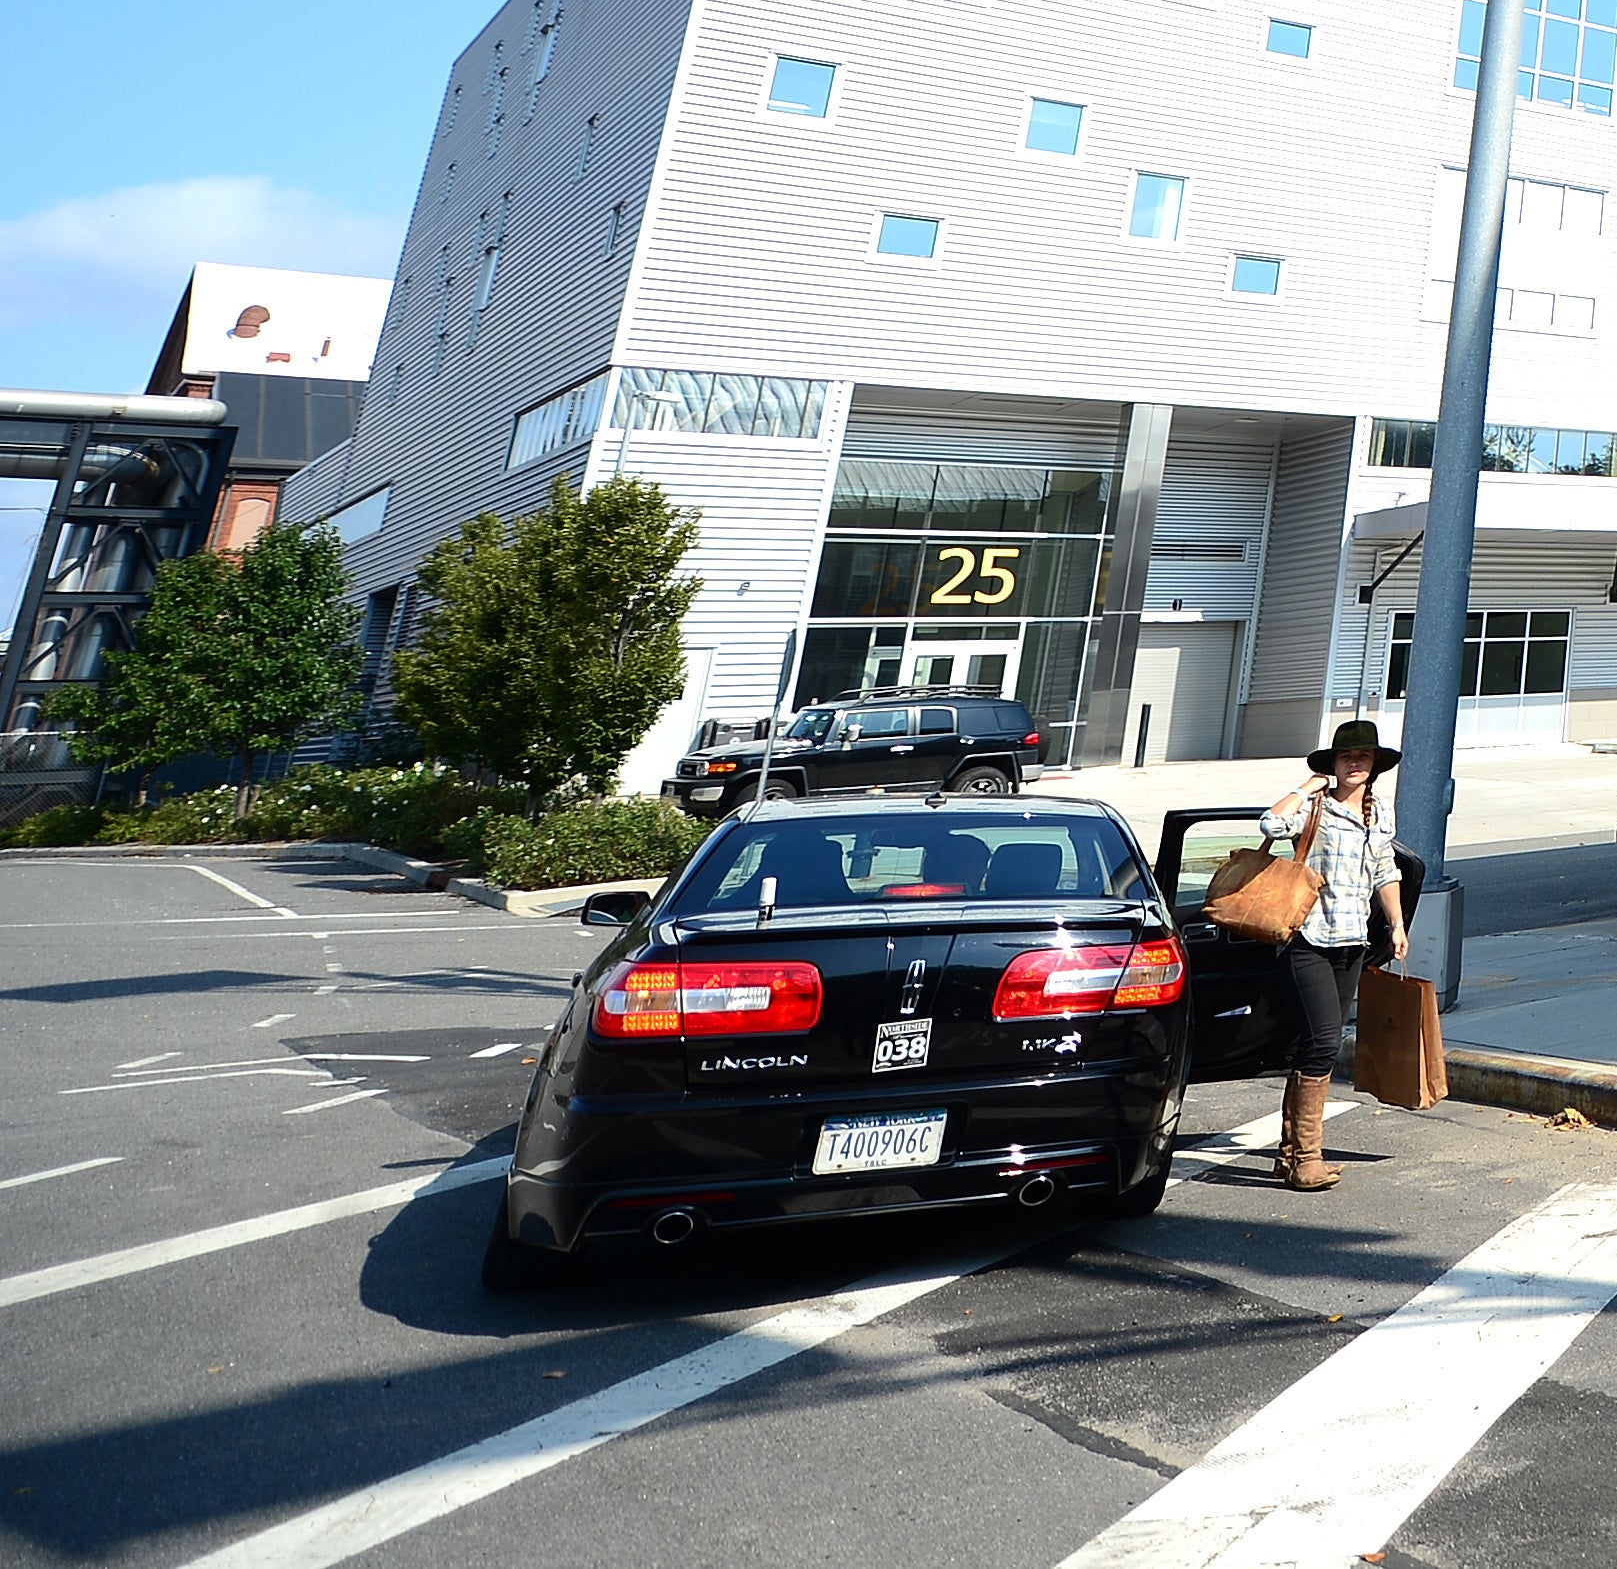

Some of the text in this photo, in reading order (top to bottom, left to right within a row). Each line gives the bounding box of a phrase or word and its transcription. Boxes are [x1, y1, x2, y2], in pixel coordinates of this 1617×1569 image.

[930, 547, 1020, 604] 25
[700, 1054, 809, 1071] LINCOLN
[877, 1036, 927, 1062] 038
[828, 1126, 932, 1162] T400906C
